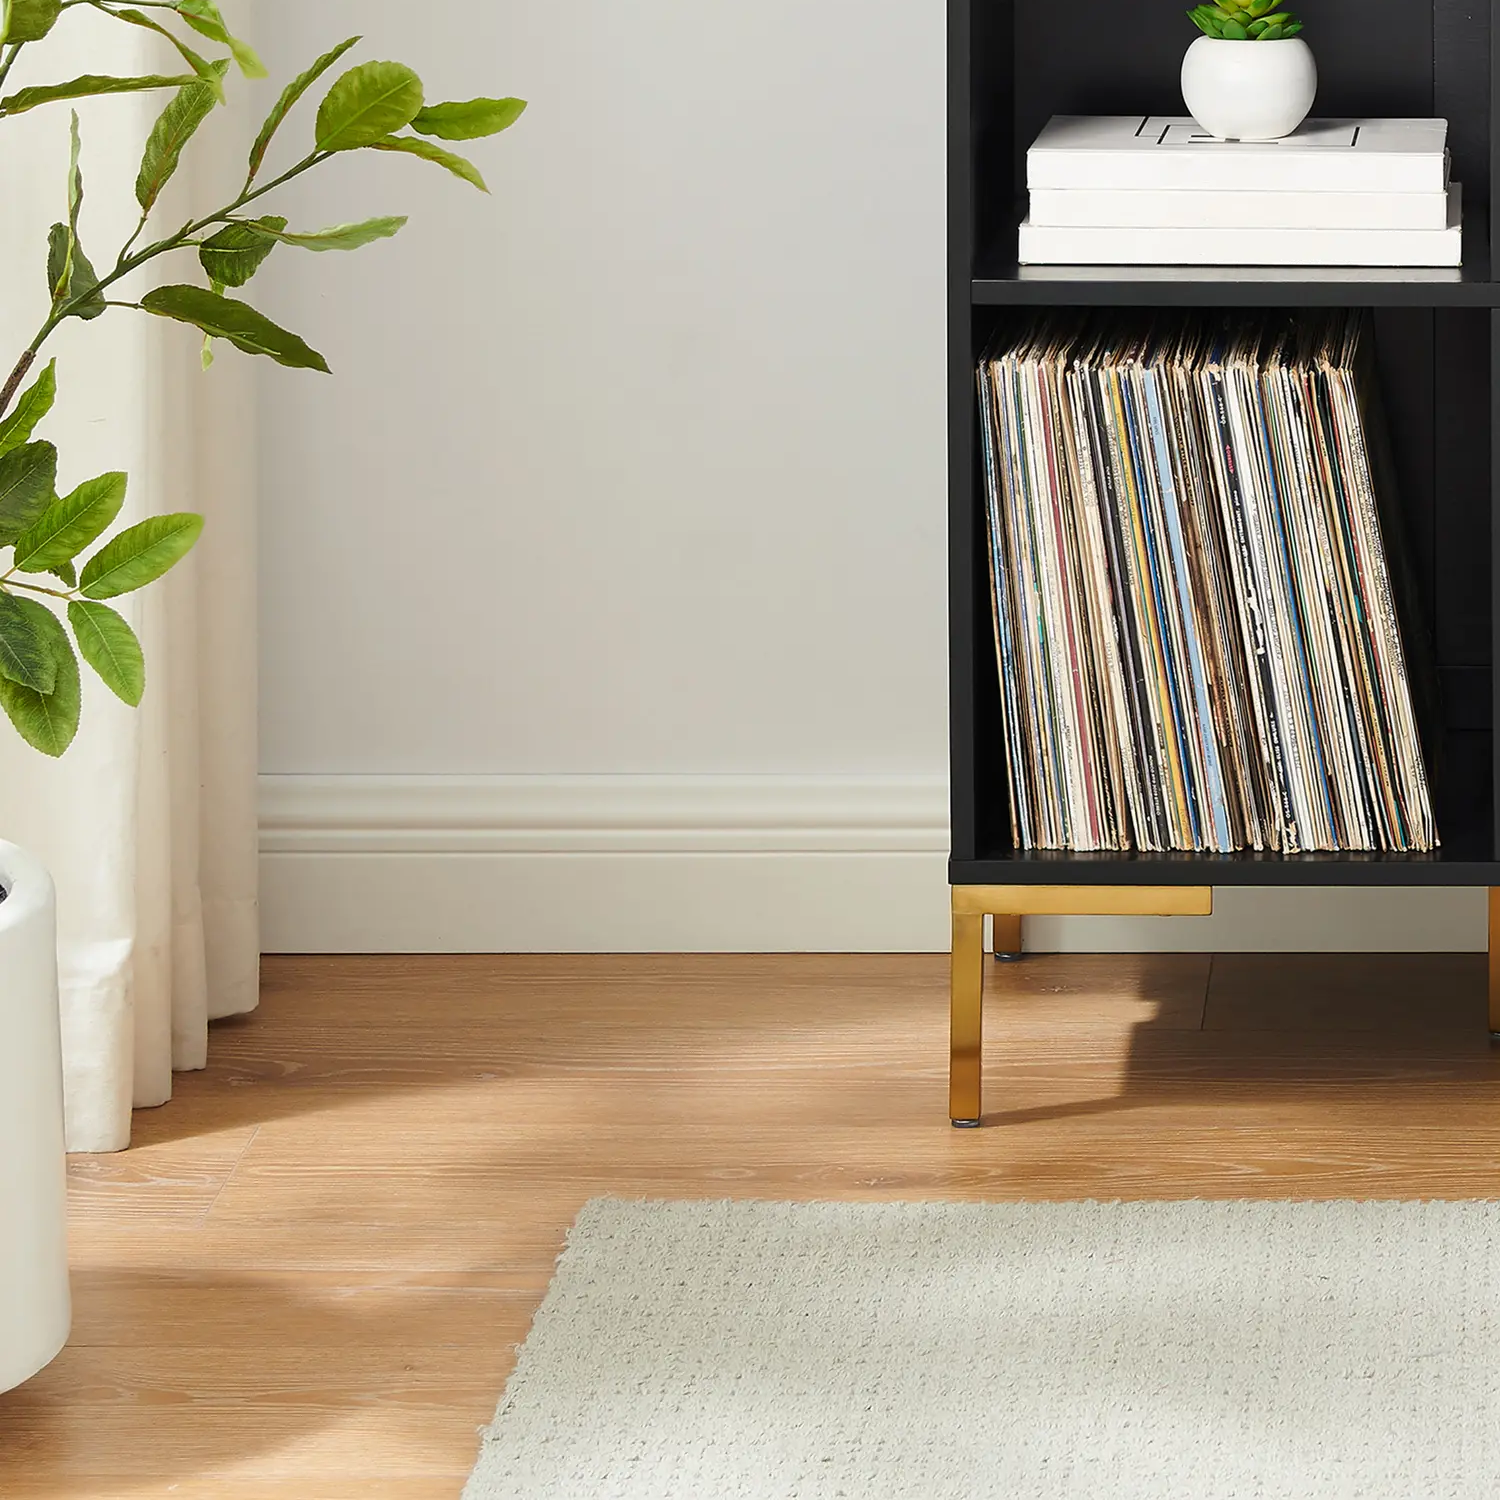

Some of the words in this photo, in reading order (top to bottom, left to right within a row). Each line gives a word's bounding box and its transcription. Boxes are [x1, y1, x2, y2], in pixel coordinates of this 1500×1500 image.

[1077, 447, 1085, 470] STEREO
[1231, 488, 1240, 507] piano
[1153, 795, 1161, 816] STEREO
